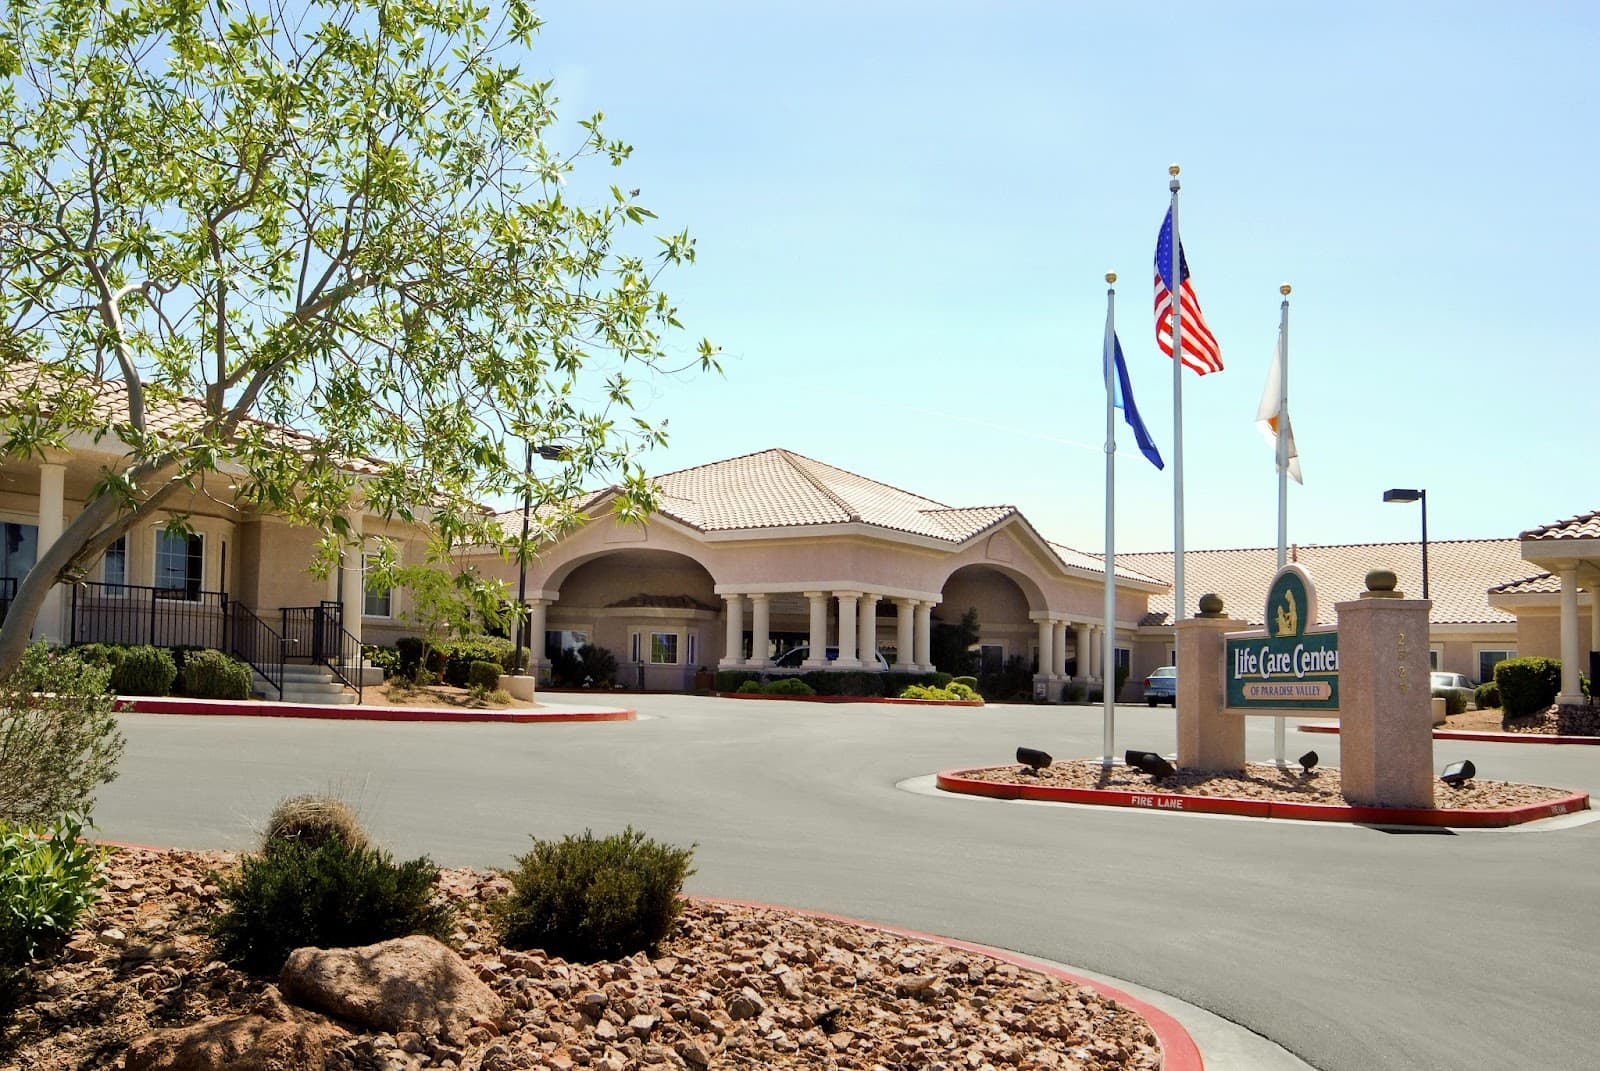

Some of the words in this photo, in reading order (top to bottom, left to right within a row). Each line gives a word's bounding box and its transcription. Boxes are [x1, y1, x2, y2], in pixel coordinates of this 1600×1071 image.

[1234, 647, 1257, 679] Life
[1260, 646, 1291, 679] Care
[1250, 686, 1260, 696] OF
[1261, 686, 1294, 696] PARADISE
[1296, 686, 1320, 696] VALLEY
[1131, 795, 1153, 807] FIRE
[1158, 798, 1183, 809] LANE
